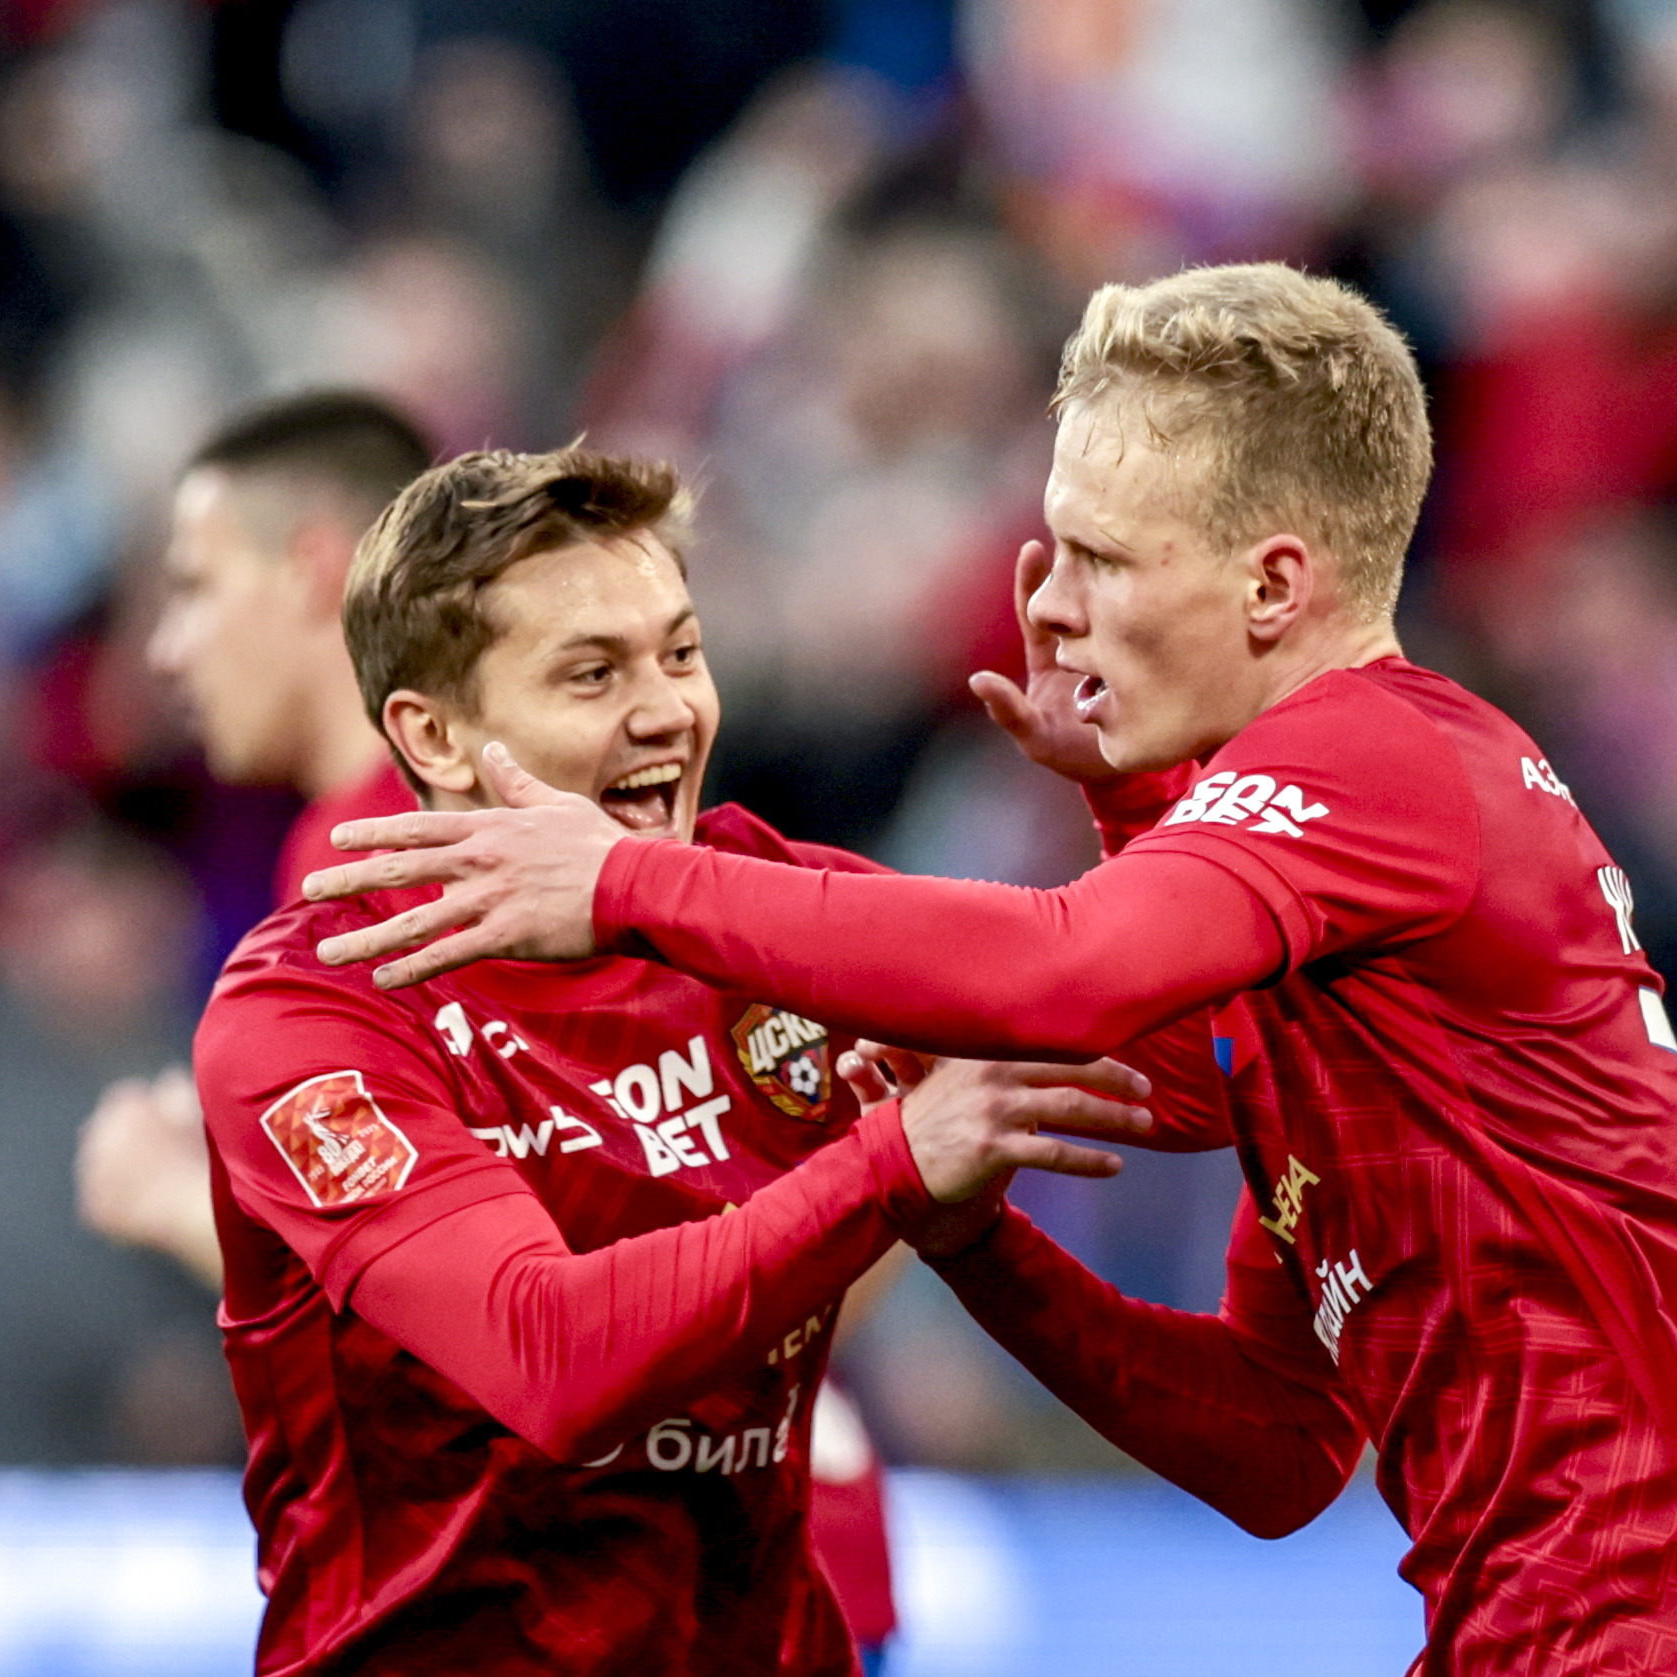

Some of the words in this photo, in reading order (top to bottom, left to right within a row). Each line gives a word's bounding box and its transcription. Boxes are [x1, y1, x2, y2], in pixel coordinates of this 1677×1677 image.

[1163, 797, 1304, 838] BET
[1192, 771, 1330, 823] FON
[632, 1094, 731, 1178] BET
[342, 1155, 378, 1192] FONBET
